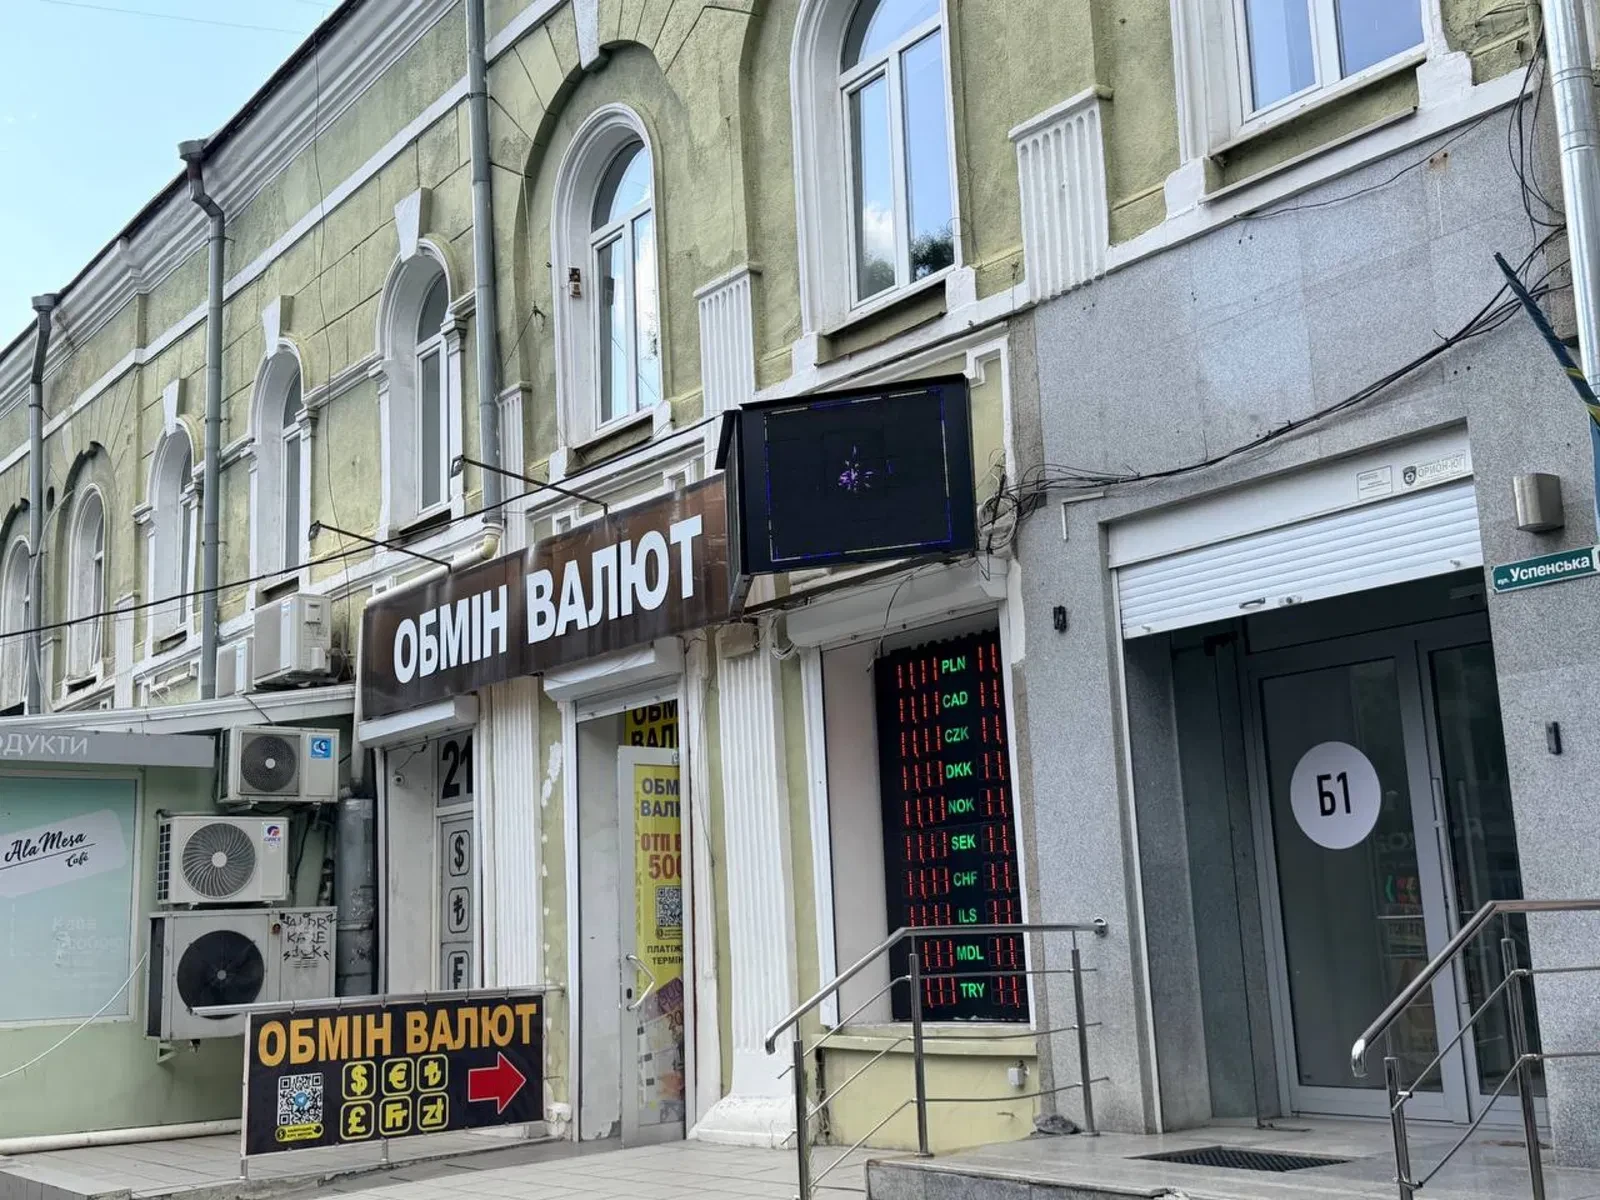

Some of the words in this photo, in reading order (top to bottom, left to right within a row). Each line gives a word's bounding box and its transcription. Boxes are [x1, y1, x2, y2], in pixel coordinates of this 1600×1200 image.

[1509, 556, 1591, 582] Успенська
[393, 585, 508, 684] ОБМІН
[526, 515, 702, 644] ВАЛЮТ
[942, 655, 966, 674] PLN
[942, 691, 968, 708] CAD
[631, 722, 679, 748] ВАЛ
[944, 726, 969, 743] CZK
[0, 733, 88, 756] ДУКТИ
[945, 761, 972, 779] DKK
[1316, 771, 1351, 817] Б1
[948, 798, 974, 815] NOK
[38, 831, 87, 852] Mesa
[951, 834, 976, 850] SEK
[953, 871, 977, 887] CHF
[958, 908, 977, 923] ILS
[956, 944, 984, 961] MDL
[960, 982, 985, 998] TRY
[258, 1012, 392, 1067] ОБМІН
[406, 1003, 537, 1052] ВАЛЮТ
